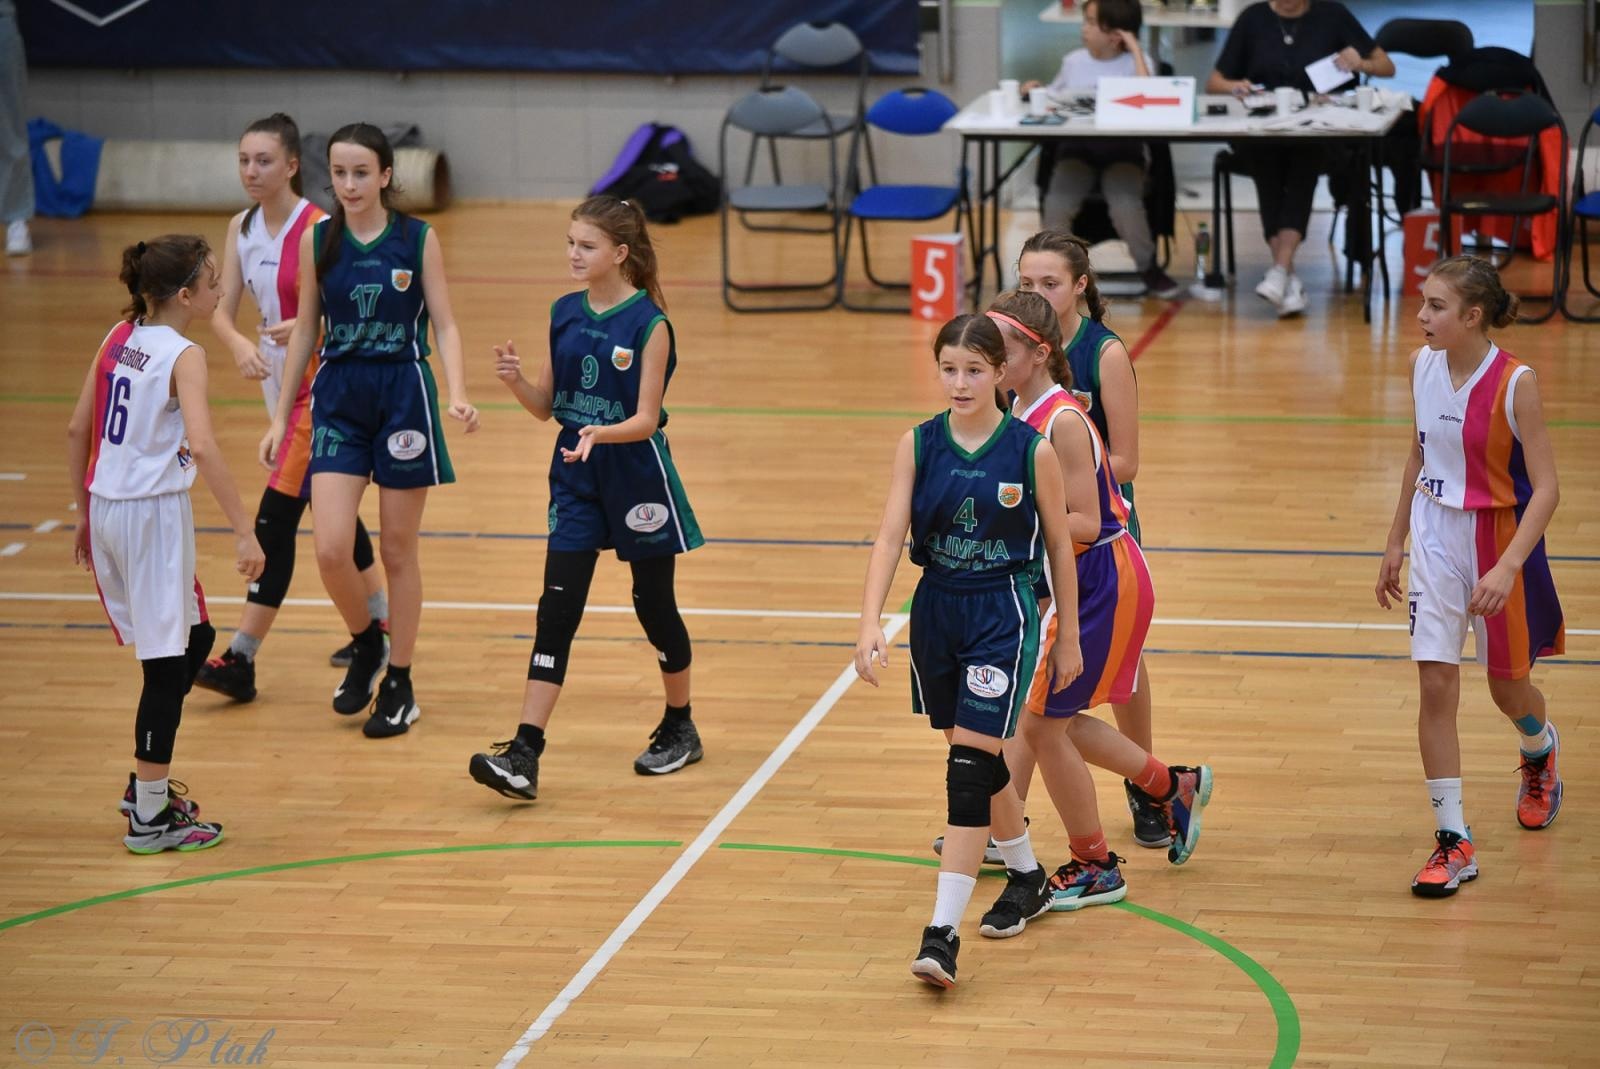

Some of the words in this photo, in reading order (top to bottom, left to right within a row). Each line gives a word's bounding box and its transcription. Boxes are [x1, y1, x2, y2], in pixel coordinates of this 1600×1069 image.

[917, 247, 946, 303] 5
[349, 284, 383, 318] 17
[581, 354, 599, 389] 9
[102, 371, 131, 446] 16
[315, 425, 344, 457] 17
[953, 497, 978, 533] 4
[538, 654, 555, 668] NBA
